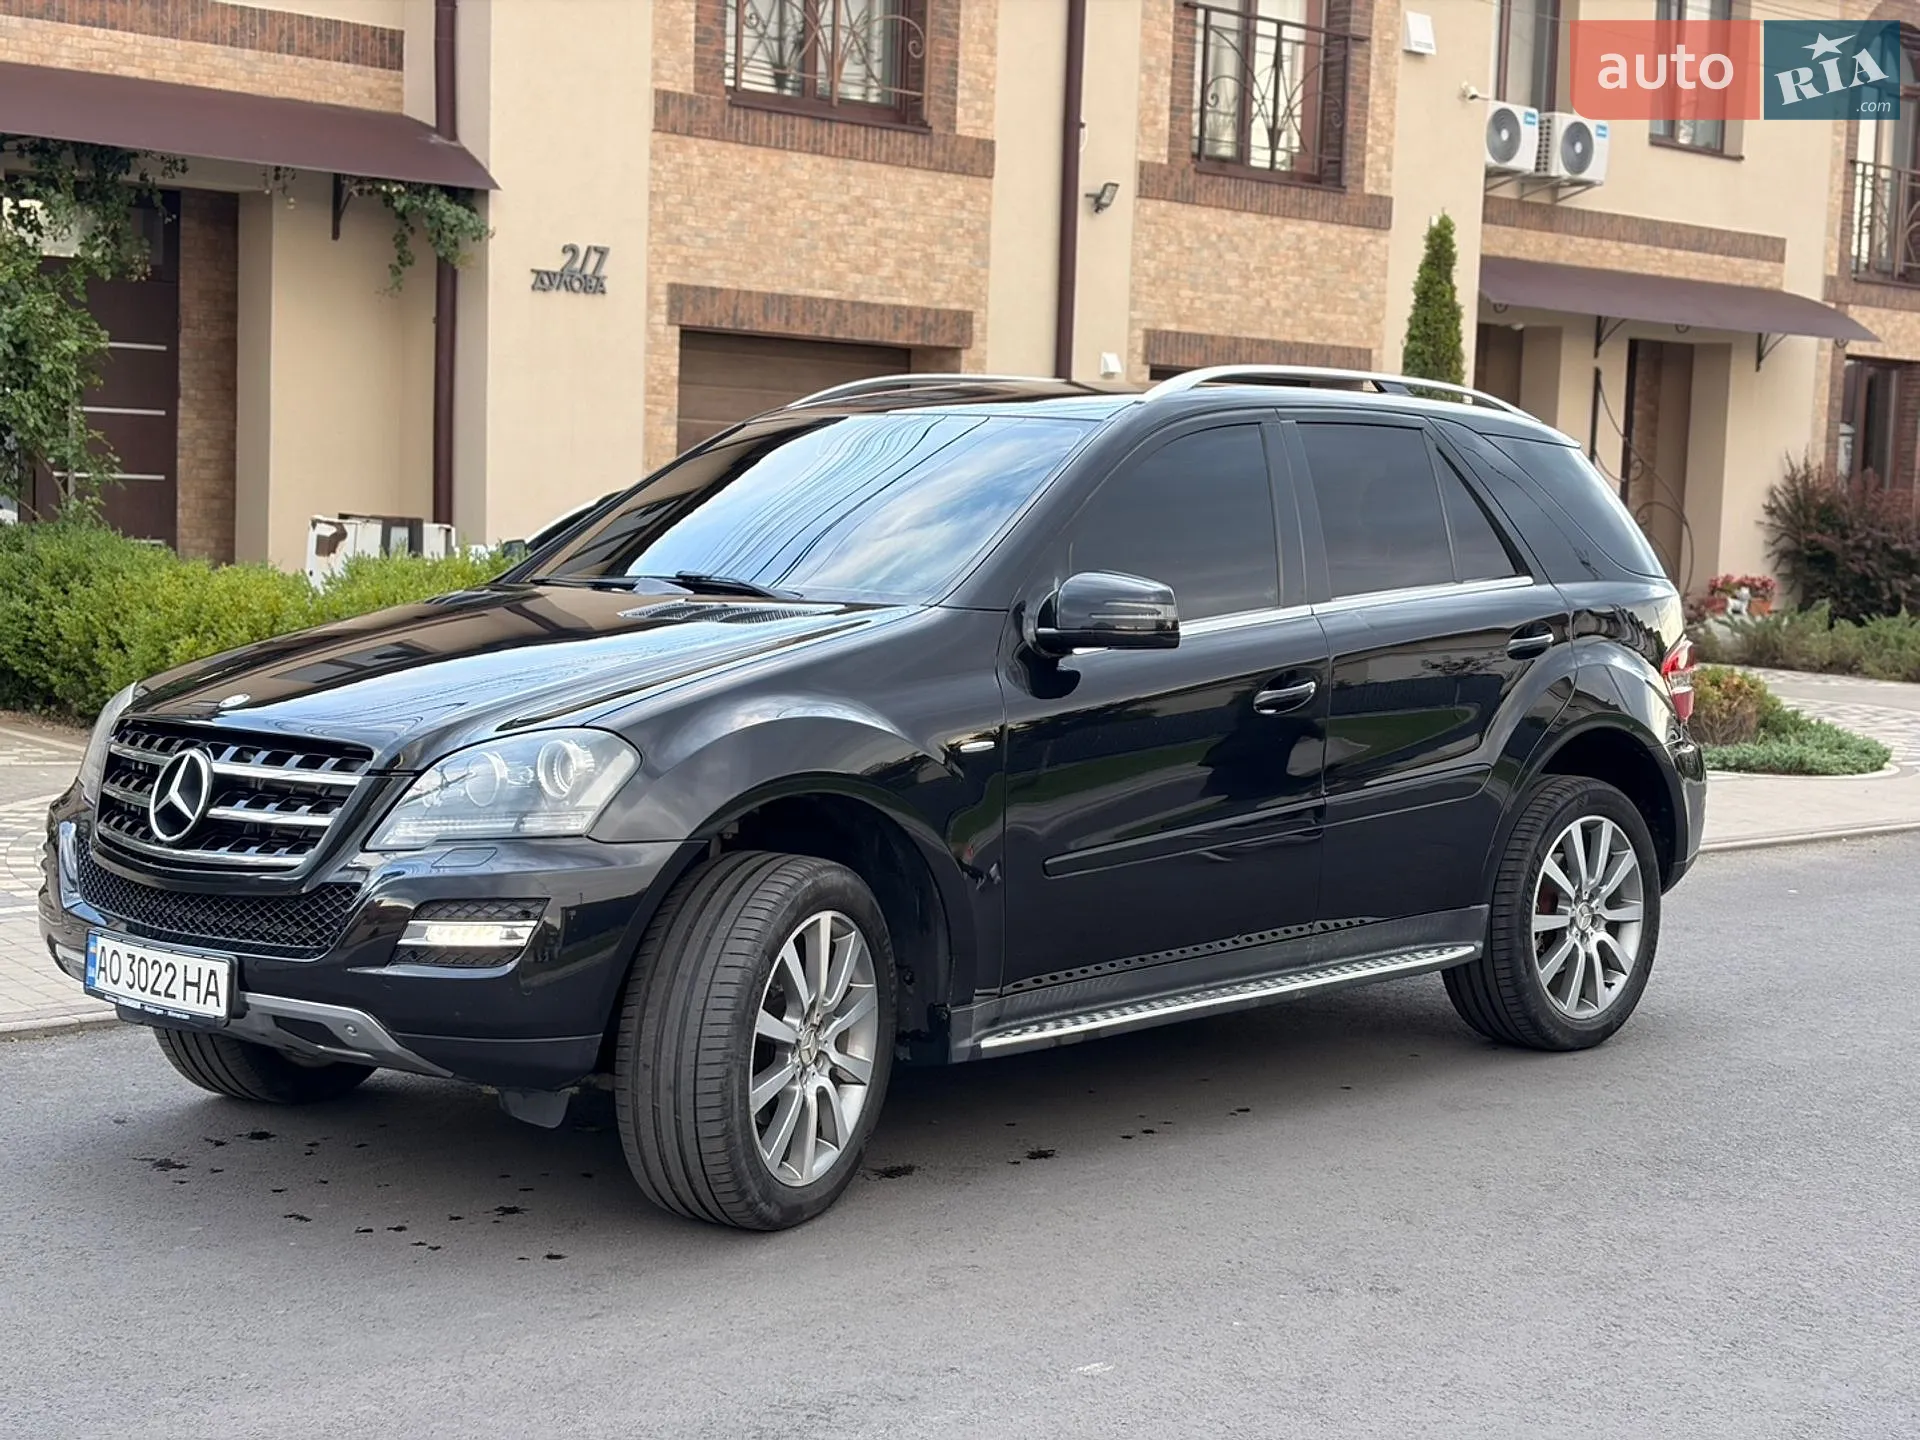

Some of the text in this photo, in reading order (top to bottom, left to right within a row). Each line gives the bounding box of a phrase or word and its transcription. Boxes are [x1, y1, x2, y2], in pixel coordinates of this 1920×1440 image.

[561, 243, 610, 277] 2/7
[97, 945, 121, 985] AO
[125, 953, 177, 1000] 3022
[182, 965, 220, 1008] HA
